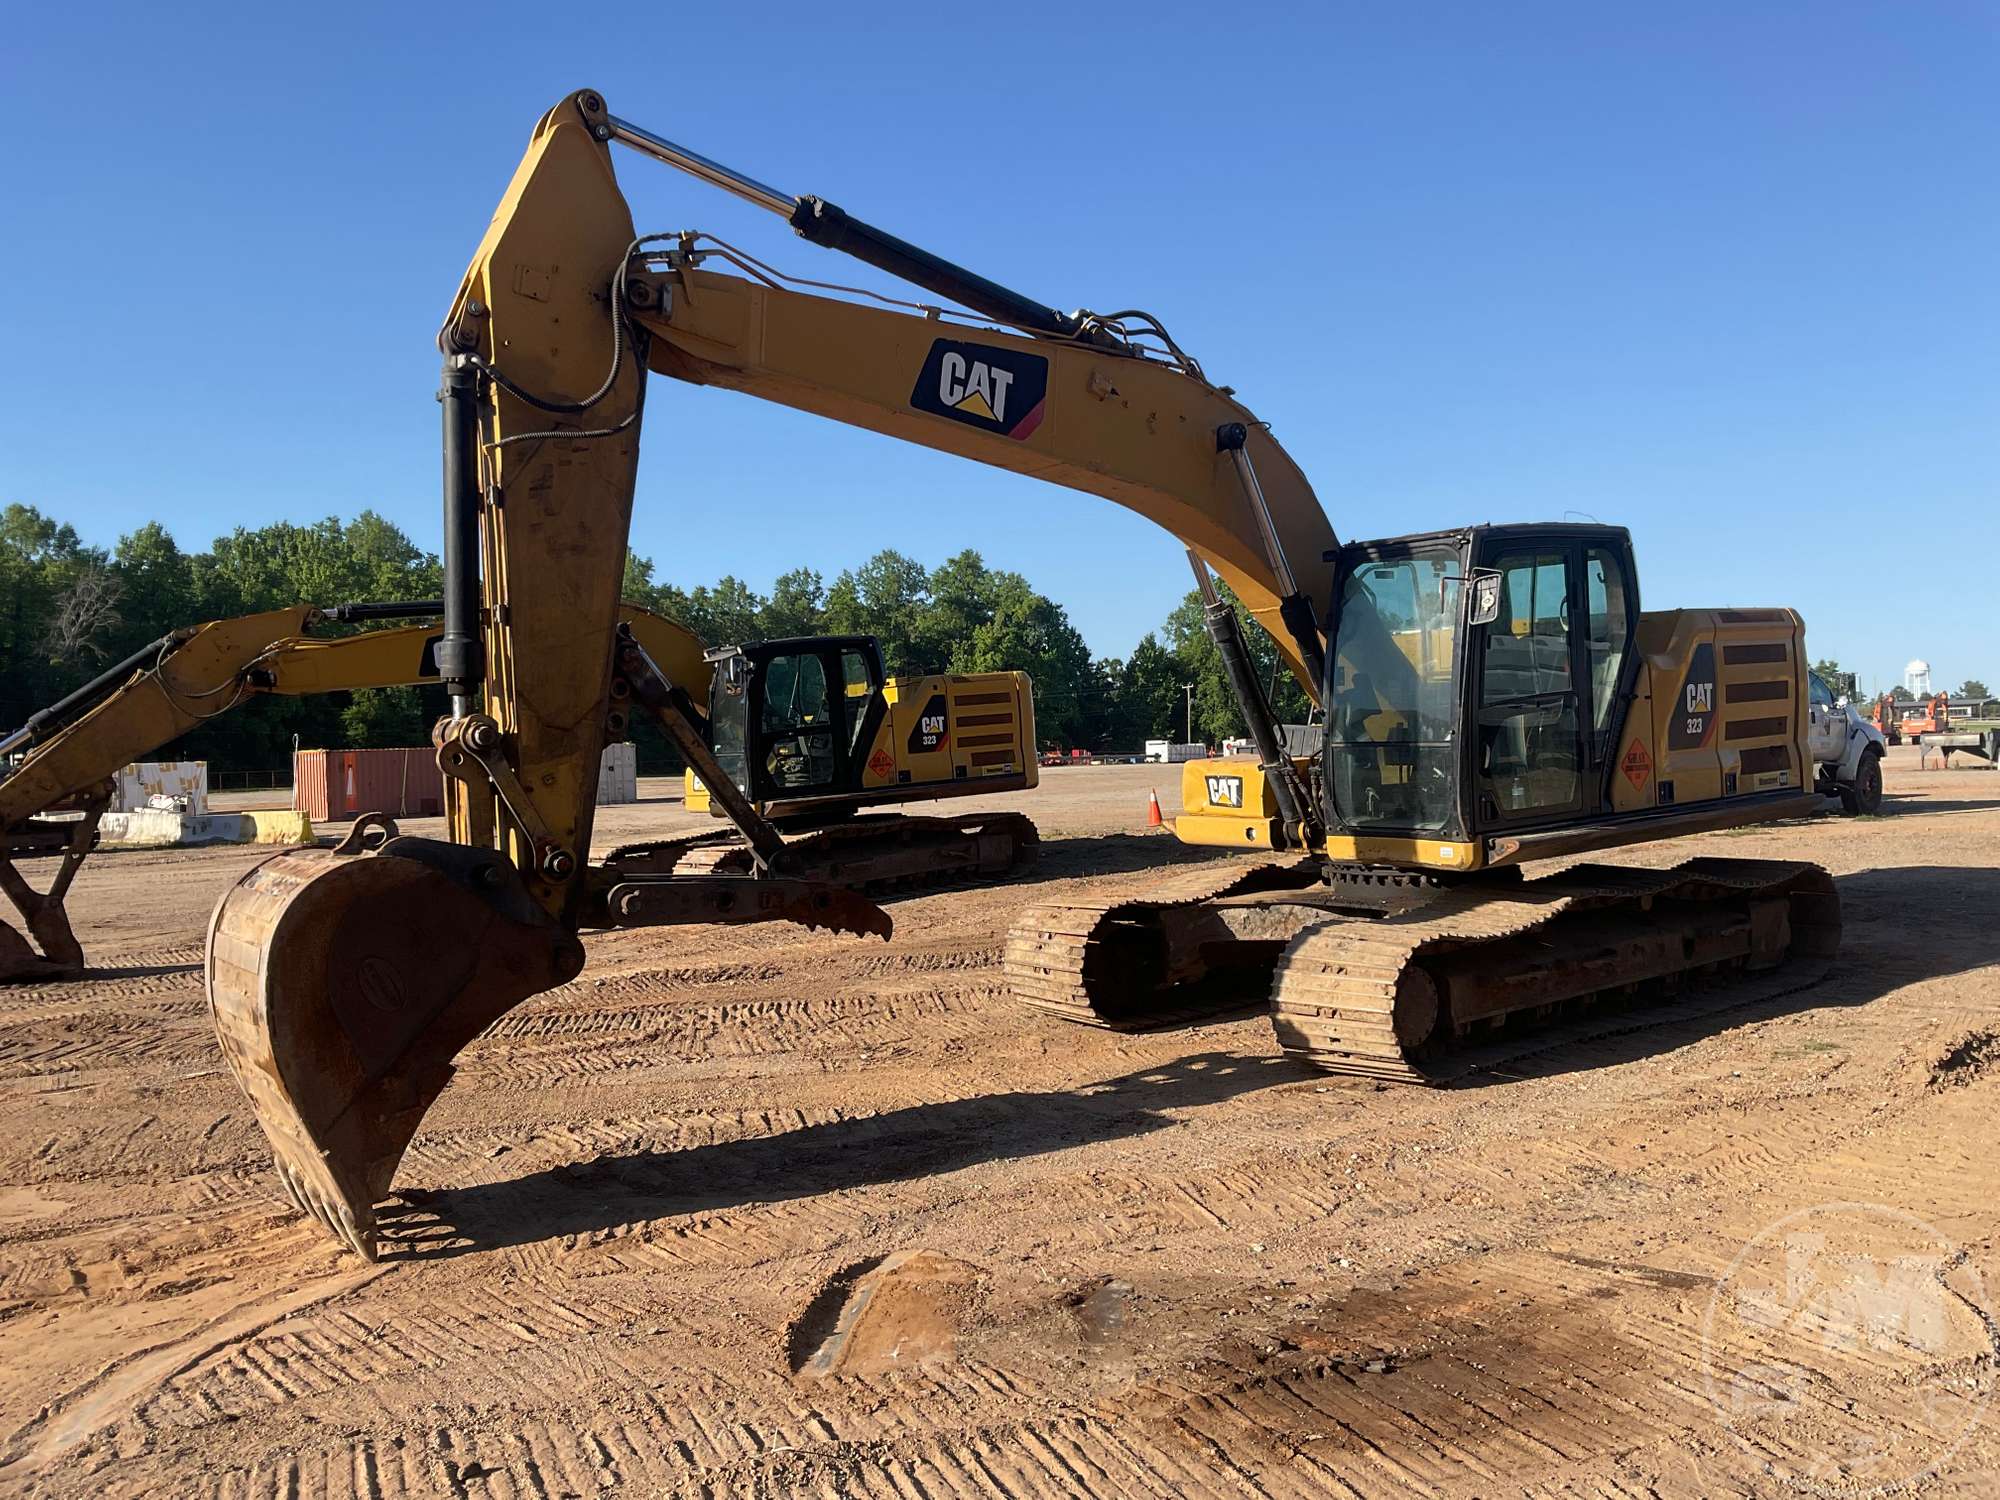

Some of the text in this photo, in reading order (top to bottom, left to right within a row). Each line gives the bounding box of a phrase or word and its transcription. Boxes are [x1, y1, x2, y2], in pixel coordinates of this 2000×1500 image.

[939, 351, 1014, 423] CAT
[1686, 683, 1713, 713] CAT
[921, 716, 945, 734] CAT
[1686, 717, 1703, 734] 323
[922, 735, 937, 745] 323
[1208, 778, 1241, 807] CAT
